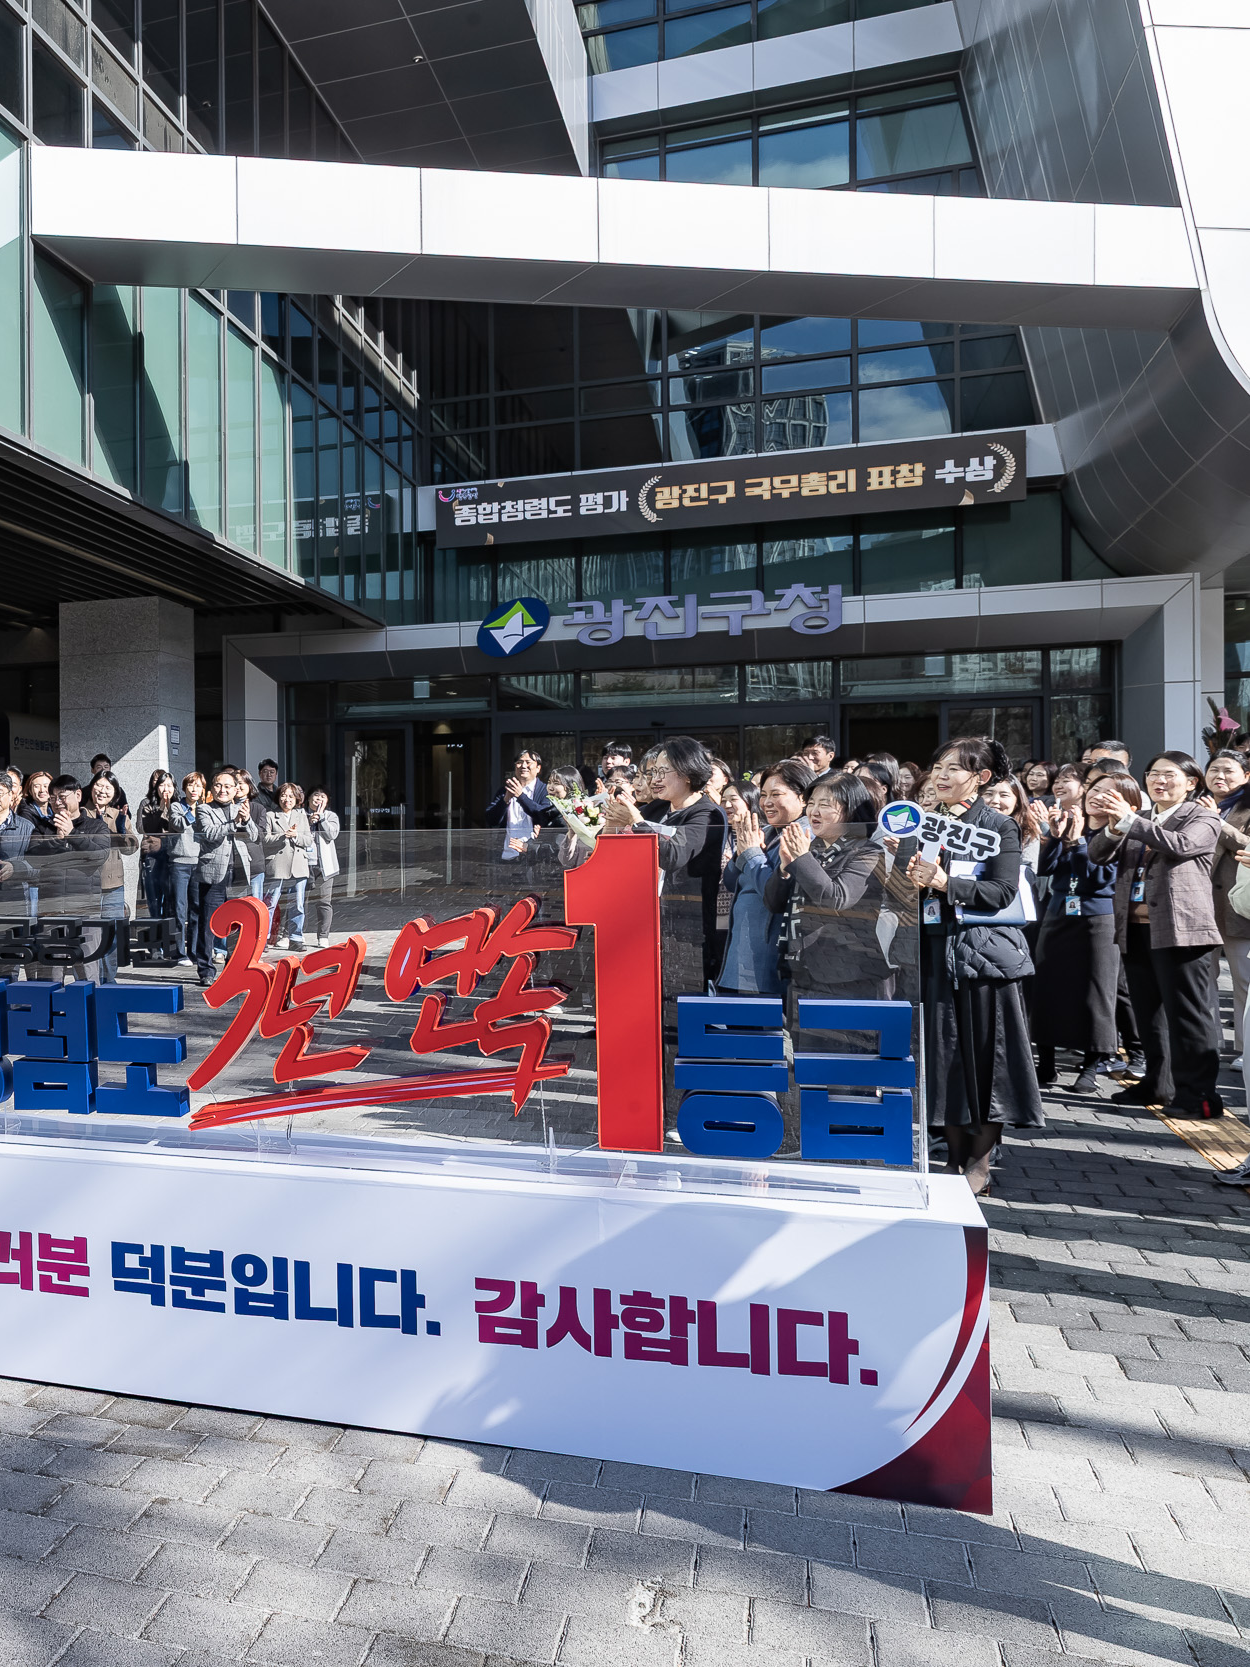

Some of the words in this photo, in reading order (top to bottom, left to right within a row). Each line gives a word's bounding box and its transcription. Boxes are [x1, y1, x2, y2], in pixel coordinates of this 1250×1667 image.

[454, 495, 572, 526] 종합청렴도
[579, 490, 629, 515] 평가
[654, 480, 736, 510] 광진구
[745, 468, 856, 501] 국무총리
[866, 462, 925, 491] 표창
[934, 455, 996, 484] 수상
[562, 583, 843, 647] 광진구청
[921, 814, 996, 857] 광진구
[187, 894, 372, 1091] 3년
[384, 893, 579, 1116] 연속
[111, 1241, 441, 1336] 덕분입니다.
[474, 1276, 879, 1387] 감사합니다.
